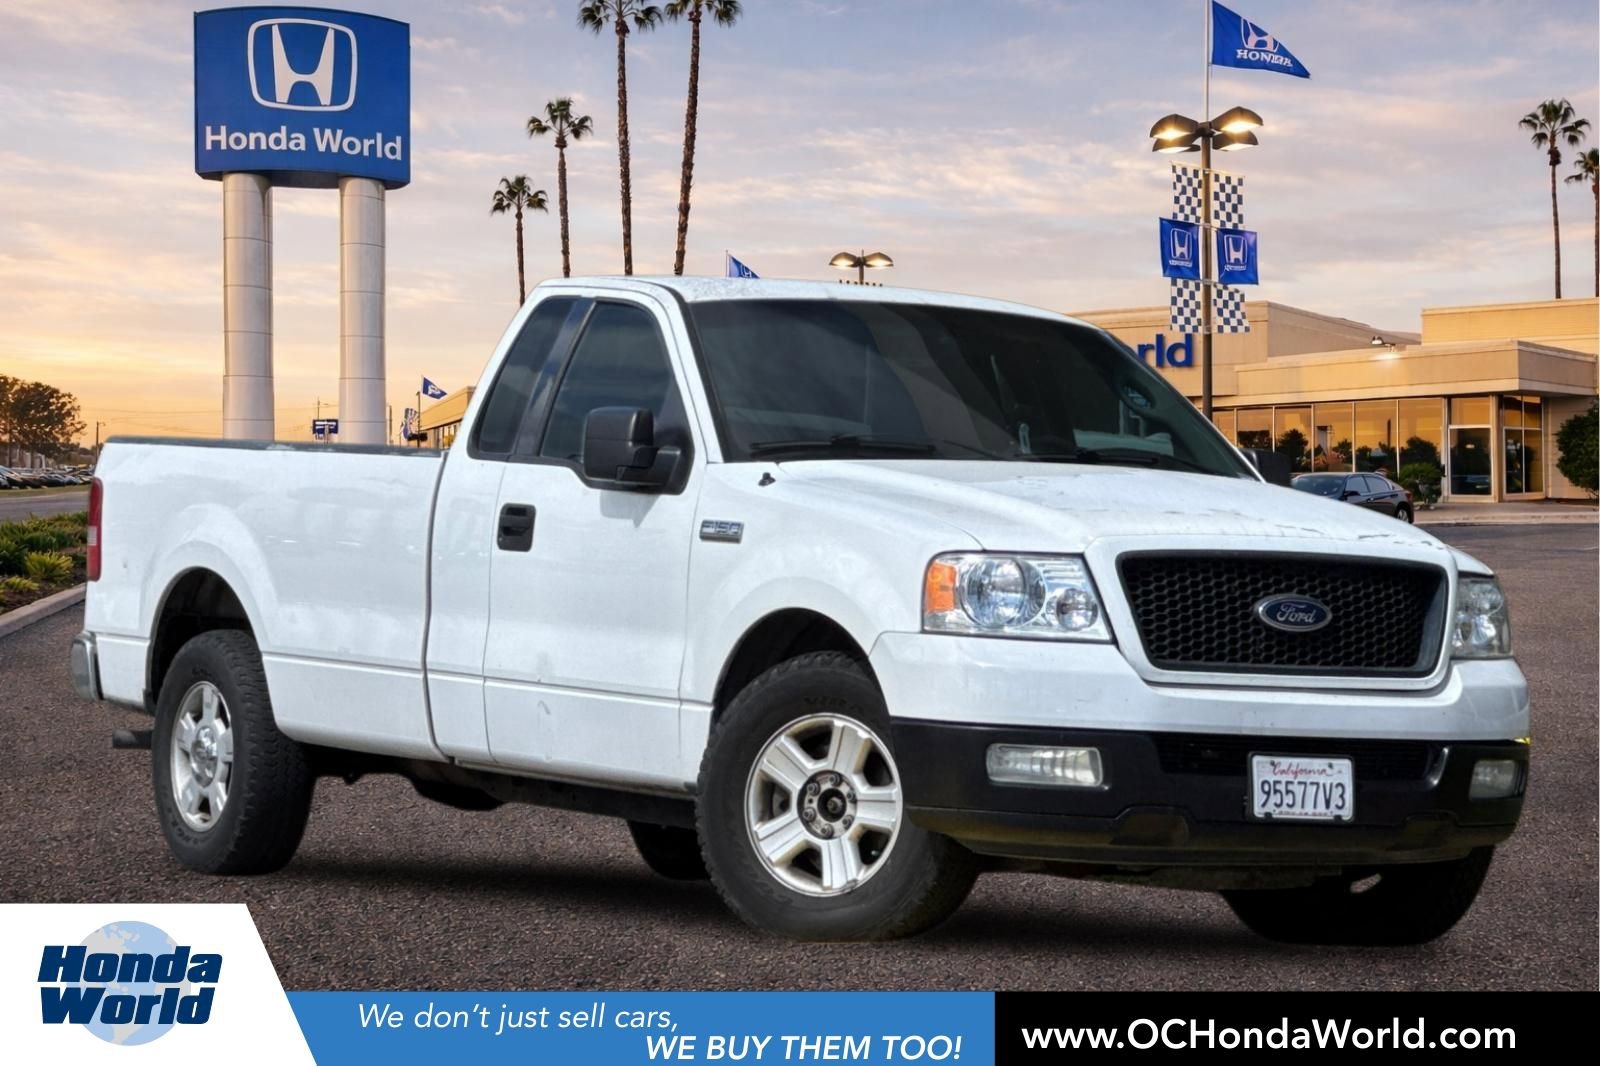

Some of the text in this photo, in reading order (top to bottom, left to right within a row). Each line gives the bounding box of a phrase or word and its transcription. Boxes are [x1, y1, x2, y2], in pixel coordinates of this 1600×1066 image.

[1236, 49, 1293, 67] HONDA
[205, 125, 402, 160] Honda World
[1276, 602, 1317, 623] Ford
[1271, 762, 1333, 779] California
[1260, 780, 1346, 810] 95577V3
